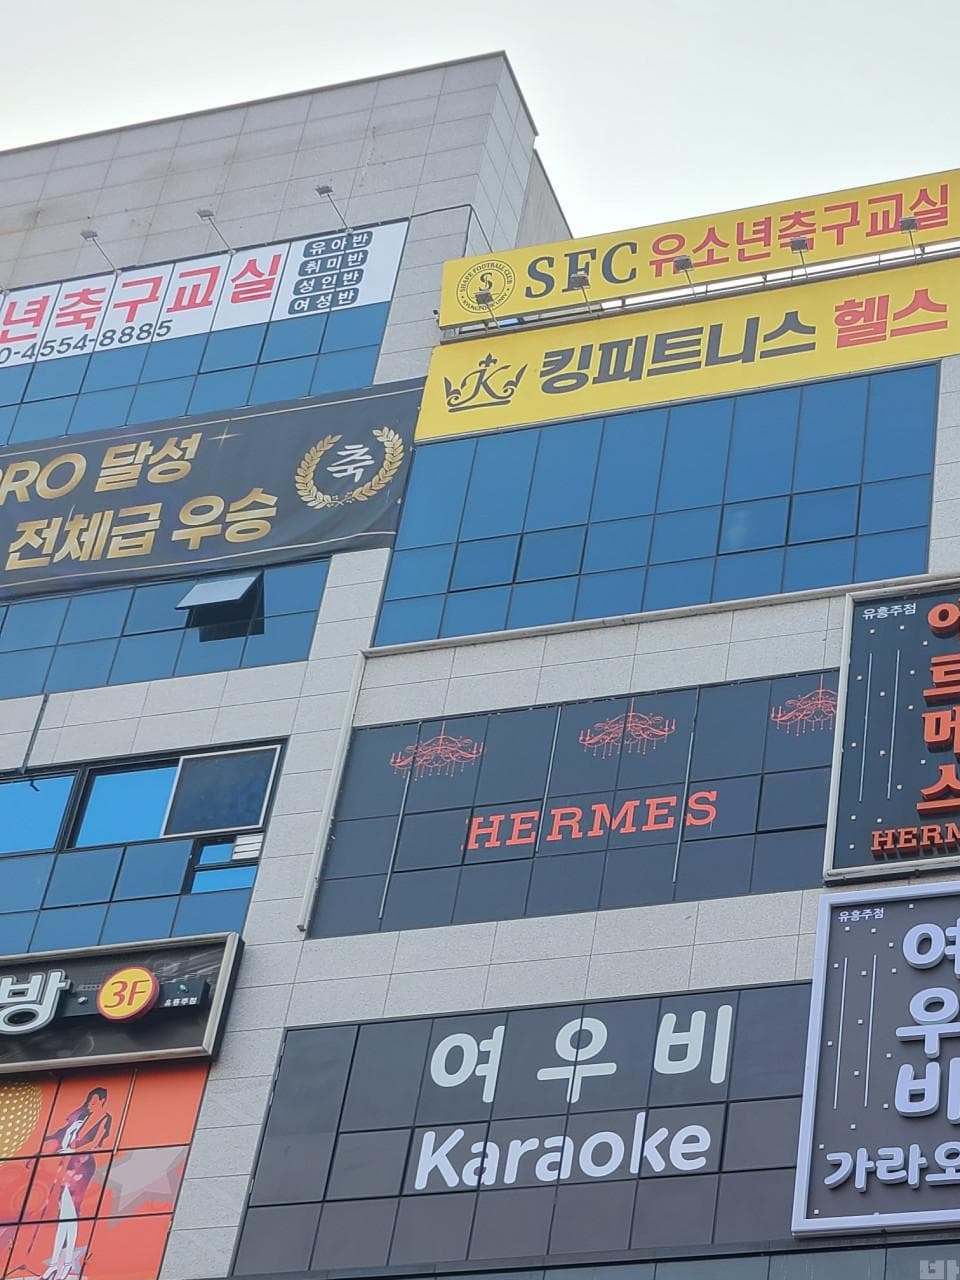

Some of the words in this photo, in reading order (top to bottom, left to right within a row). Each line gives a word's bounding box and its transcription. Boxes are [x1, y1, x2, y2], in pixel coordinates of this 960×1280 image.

[309, 233, 369, 255] 유아반
[525, 242, 637, 298] SFC
[650, 183, 949, 279] 유소년축구교실
[299, 271, 359, 293] 성인반
[304, 252, 364, 274] 취미반
[294, 290, 355, 311] 여성반
[539, 310, 816, 395] 킹피트니스
[834, 288, 948, 349] 헬스
[0, 453, 86, 505] RO
[94, 433, 202, 492] 달성
[326, 443, 375, 483] 축
[5, 502, 162, 571] 전체급
[172, 486, 278, 550] 우승
[862, 603, 916, 620] 유흥주점
[461, 790, 719, 851] HERMES
[838, 908, 884, 923] 유흥주점
[104, 978, 151, 1010] 3F
[429, 1004, 733, 1103] 여우비
[414, 1112, 712, 1190] Karaoke
